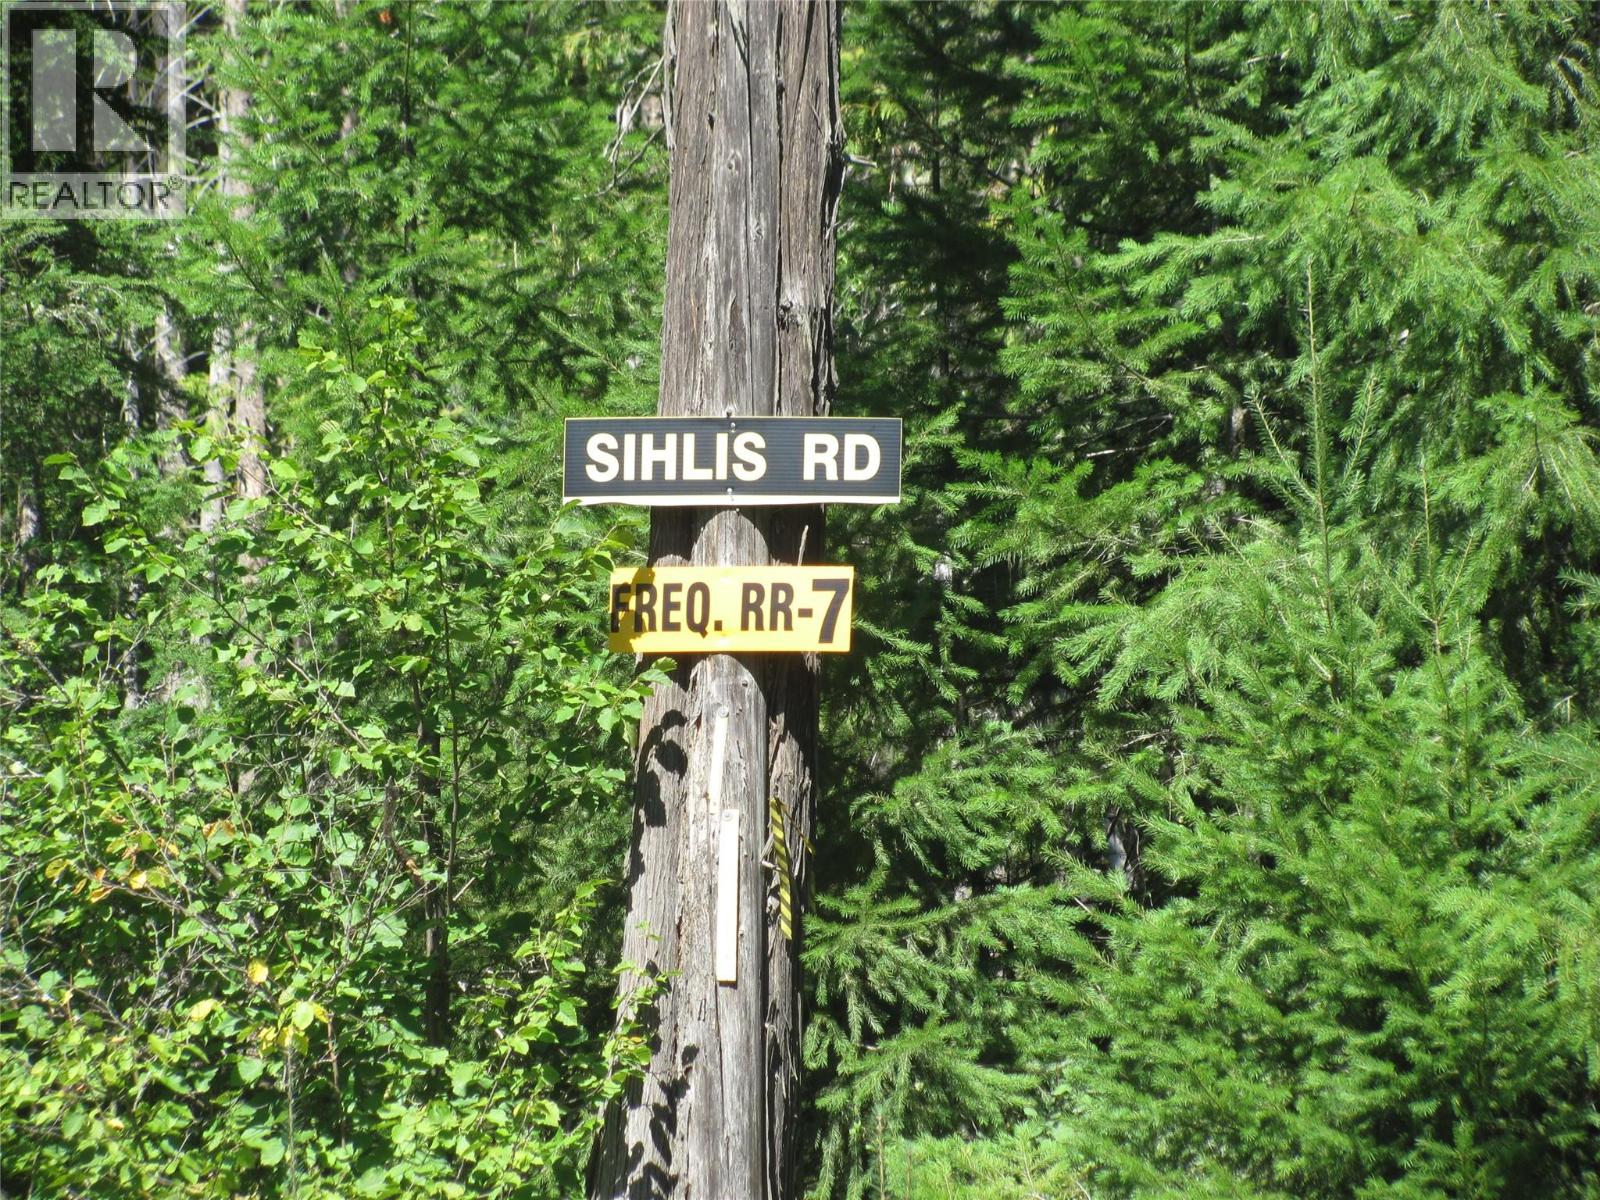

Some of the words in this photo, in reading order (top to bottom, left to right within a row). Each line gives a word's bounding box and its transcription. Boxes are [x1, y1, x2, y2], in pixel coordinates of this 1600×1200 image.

[585, 431, 767, 482] SIHLIS
[803, 433, 881, 481] RD
[610, 581, 723, 639] FREQ.
[740, 578, 850, 644] RR-7
